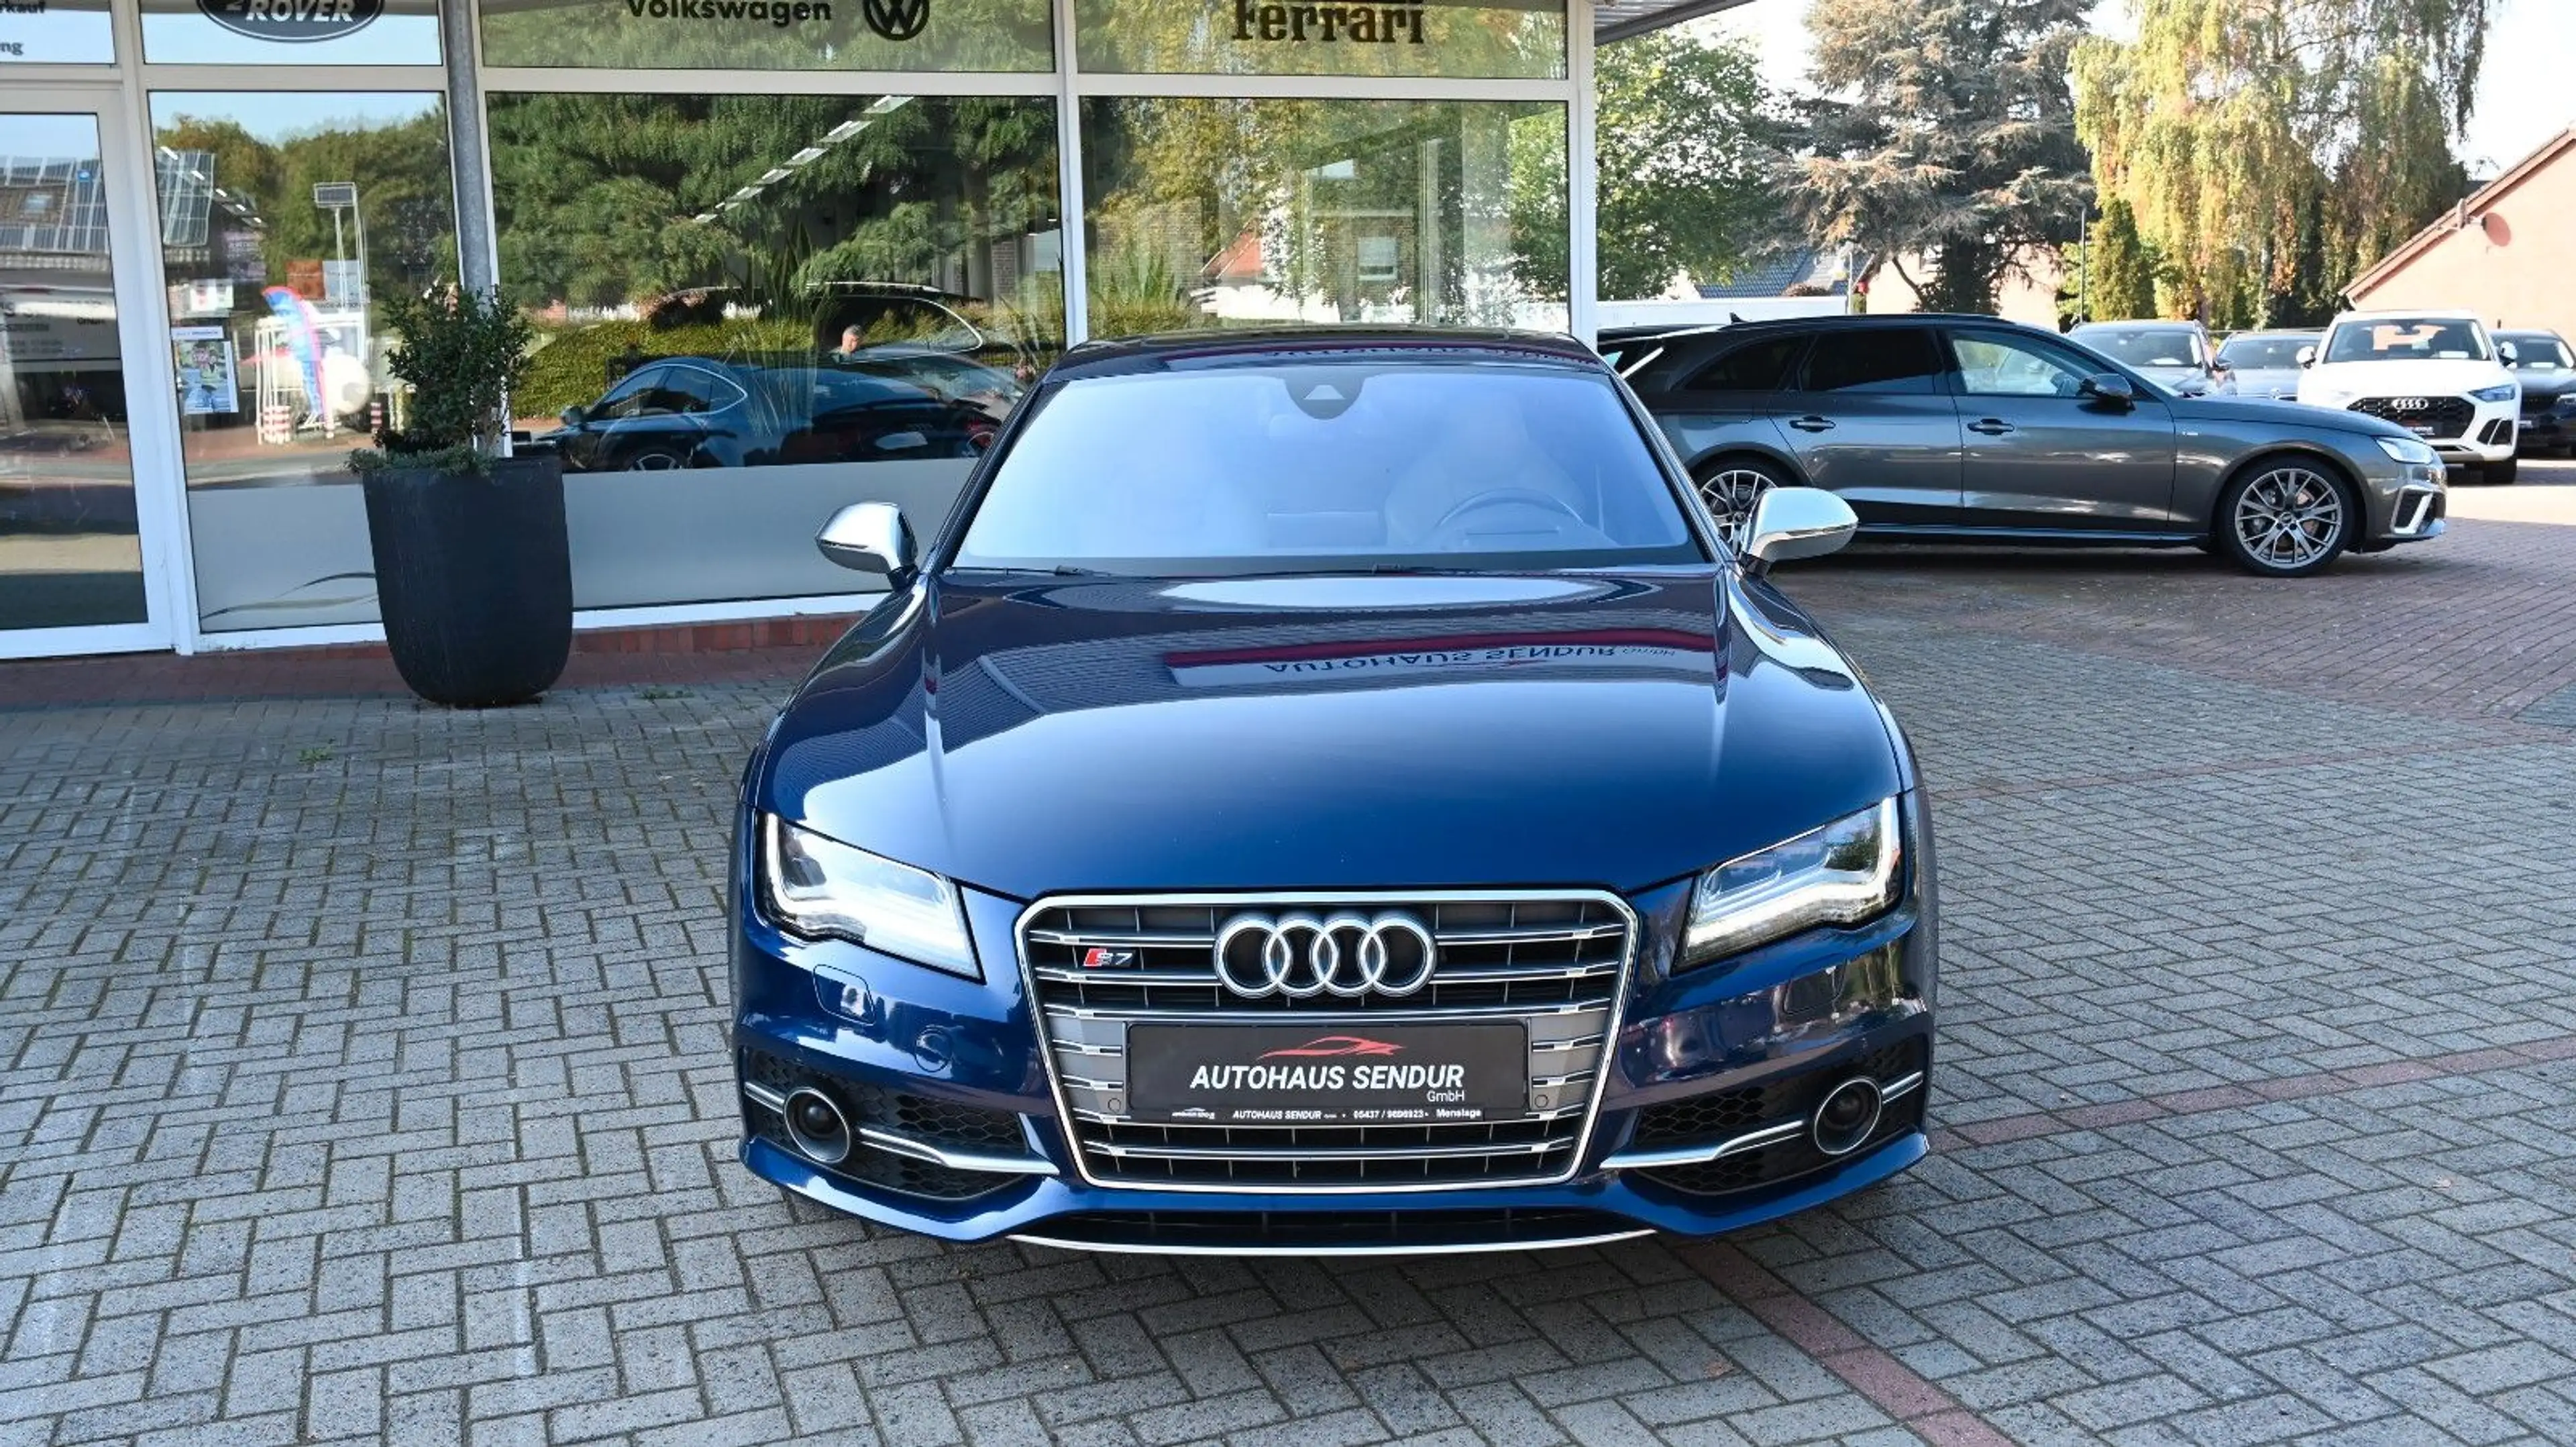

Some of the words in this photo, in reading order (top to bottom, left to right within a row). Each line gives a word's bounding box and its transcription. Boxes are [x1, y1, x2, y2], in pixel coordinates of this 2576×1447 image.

[245, 0, 356, 22] ROVER
[627, 0, 832, 28] Volkswagen
[1093, 951, 1133, 966] S7
[1189, 1065, 1344, 1090] AUTOHAUS
[1352, 1065, 1464, 1089] SENDUR
[1426, 1090, 1465, 1102] GmbH
[1232, 1110, 1283, 1120] AUTOHAUS
[1285, 1110, 1322, 1120] SENDUR
